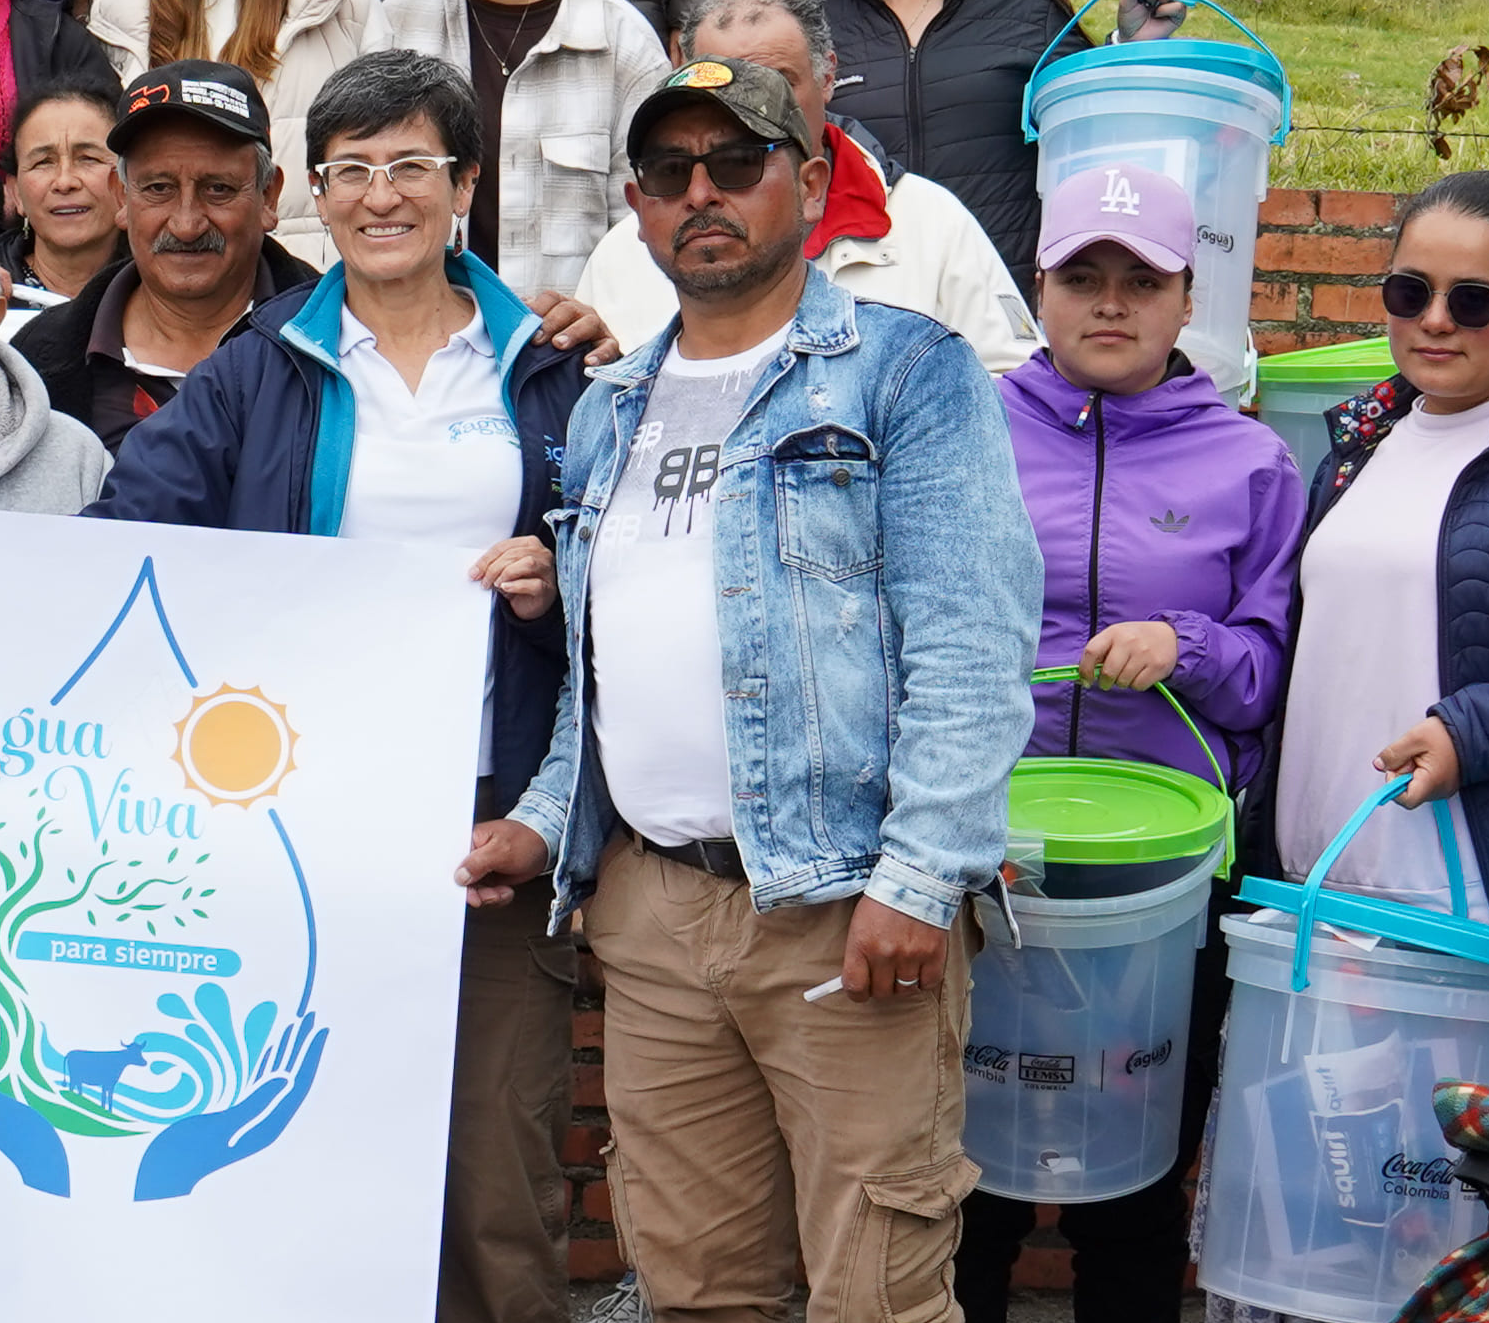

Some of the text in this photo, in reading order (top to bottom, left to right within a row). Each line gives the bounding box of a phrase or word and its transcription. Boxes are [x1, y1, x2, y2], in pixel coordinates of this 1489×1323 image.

[1100, 169, 1140, 216] LA
[1200, 229, 1229, 247] agua
[43, 765, 205, 843] Viva
[50, 938, 218, 973] para siempre
[1133, 1045, 1168, 1070] agua
[1024, 1068, 1068, 1082] FEMSA
[1325, 1130, 1358, 1209] squirt
[1383, 1180, 1450, 1201] Colombia
